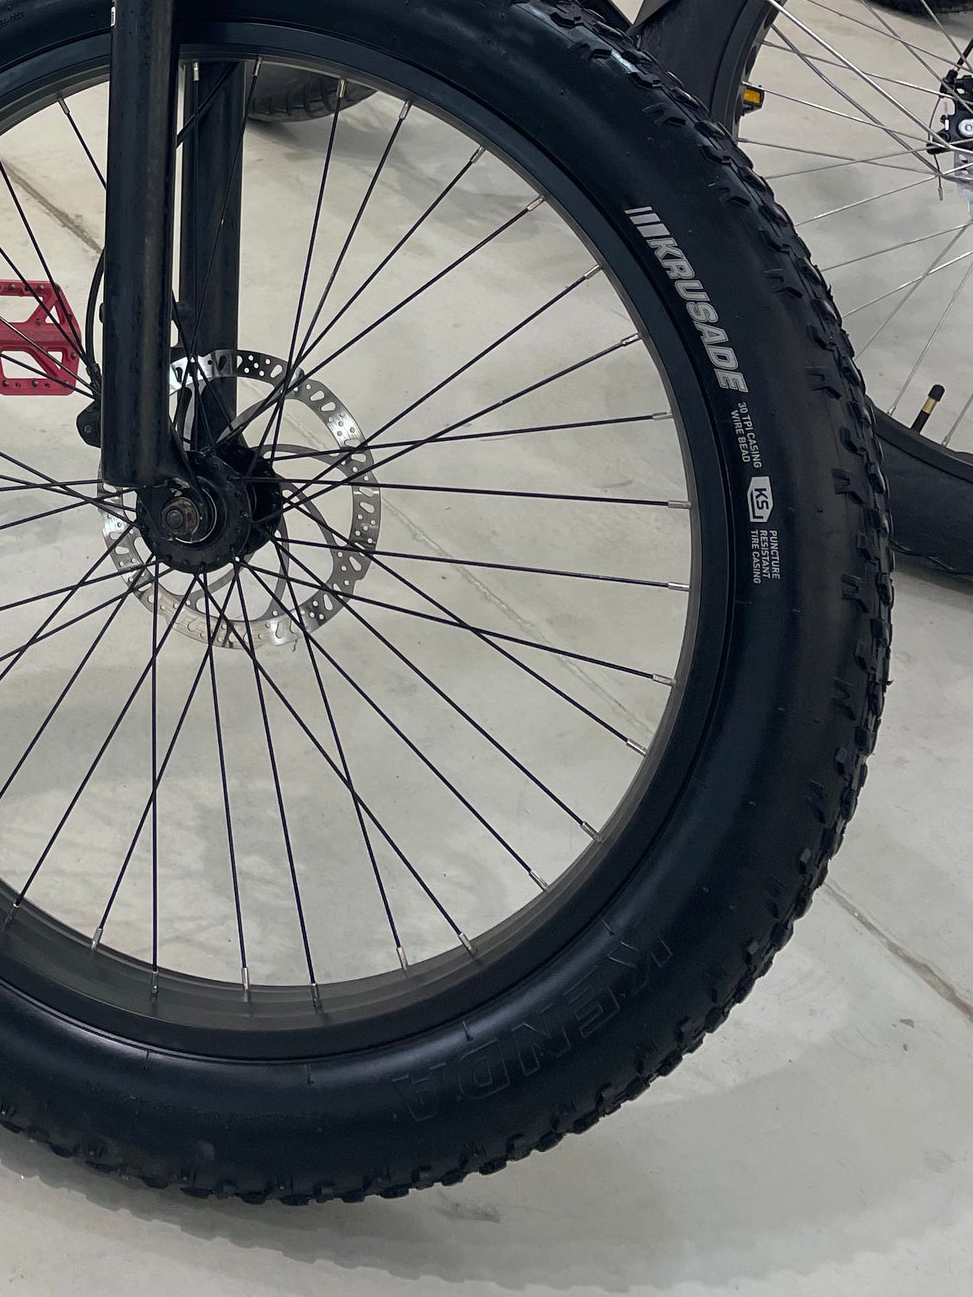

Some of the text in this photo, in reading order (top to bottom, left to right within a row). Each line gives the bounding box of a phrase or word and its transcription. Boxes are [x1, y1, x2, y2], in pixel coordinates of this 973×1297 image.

[645, 237, 749, 393] KRUSADE
[730, 410, 751, 463] WIRE BEAD
[737, 401, 763, 469] 30 TPI CASING
[750, 529, 762, 585] TIRE CASING
[759, 529, 771, 580] RESISTANT
[769, 529, 781, 580] PUNCTURE
